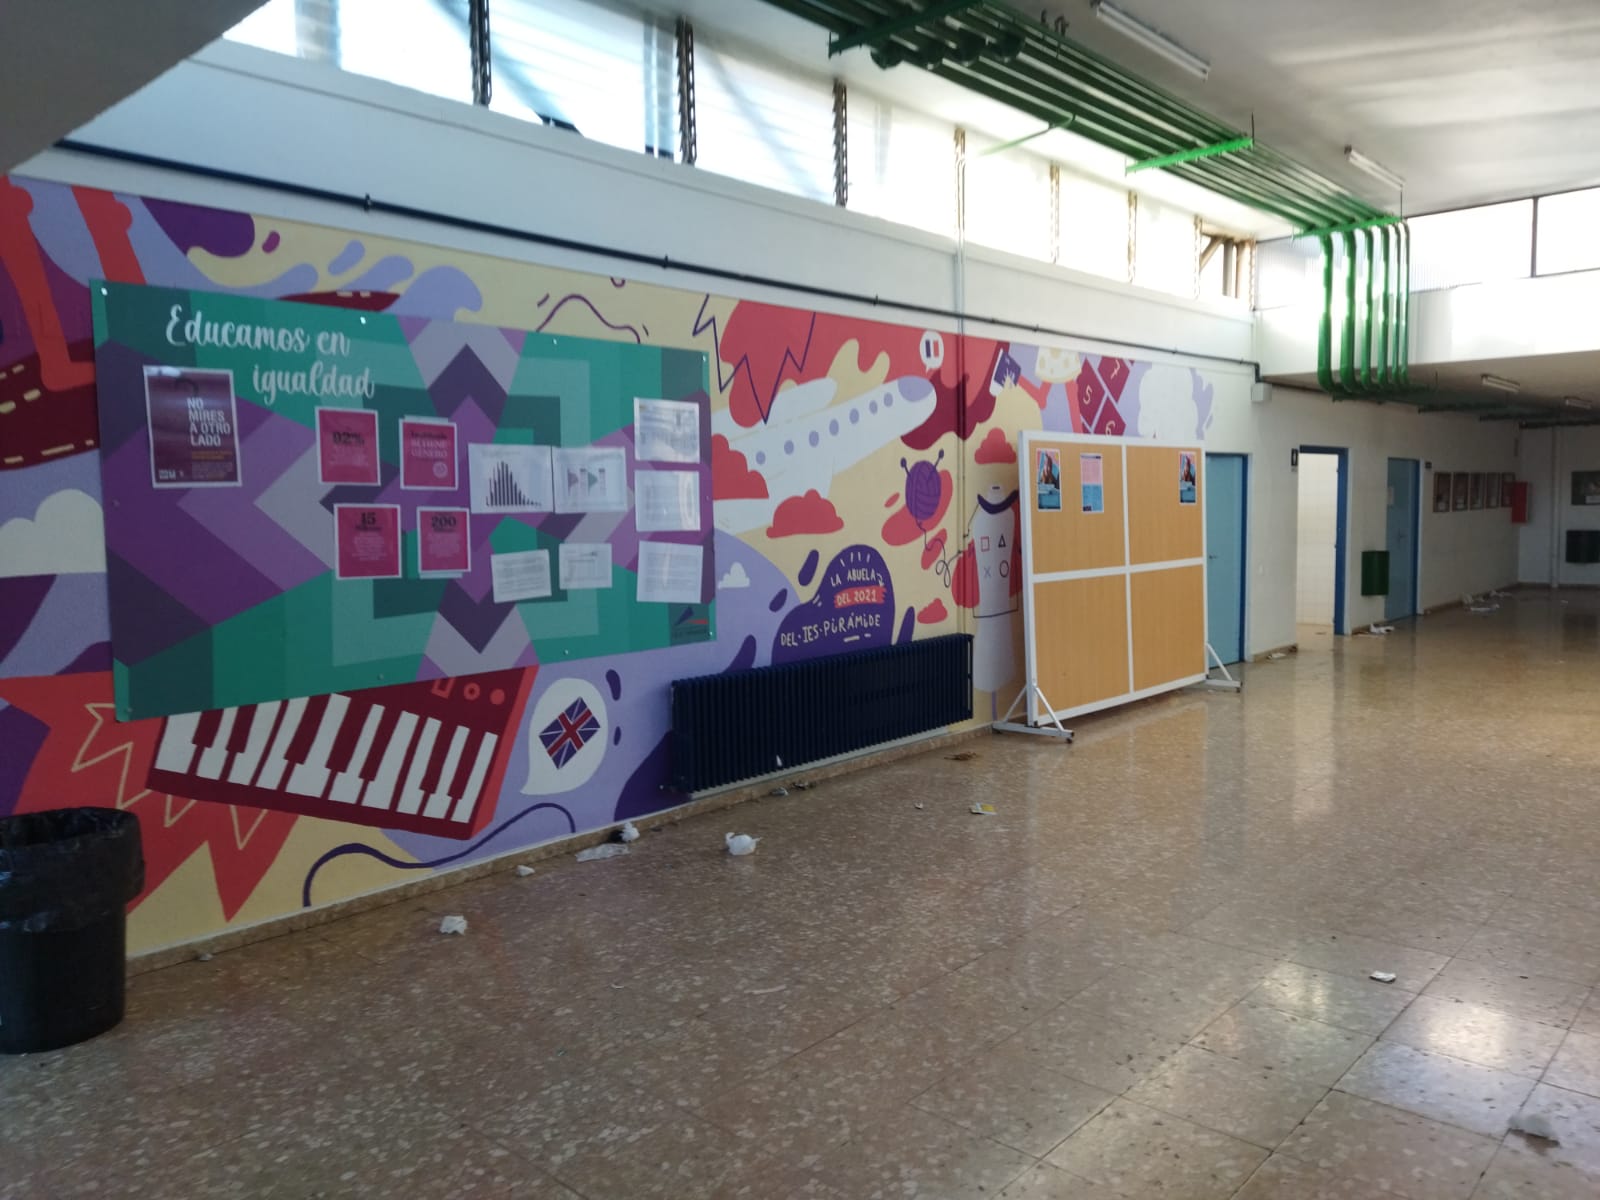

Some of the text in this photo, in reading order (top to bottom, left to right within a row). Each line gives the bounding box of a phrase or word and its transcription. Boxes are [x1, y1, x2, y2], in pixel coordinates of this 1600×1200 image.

[165, 303, 350, 358] Educamos en
[252, 361, 375, 405] igualdad
[187, 397, 204, 410] NO
[188, 410, 225, 423] MIRES
[190, 422, 231, 435] A OTRO
[191, 434, 222, 447] LADO
[830, 567, 876, 587] LA ABUELA
[837, 589, 877, 606] DEL 2021
